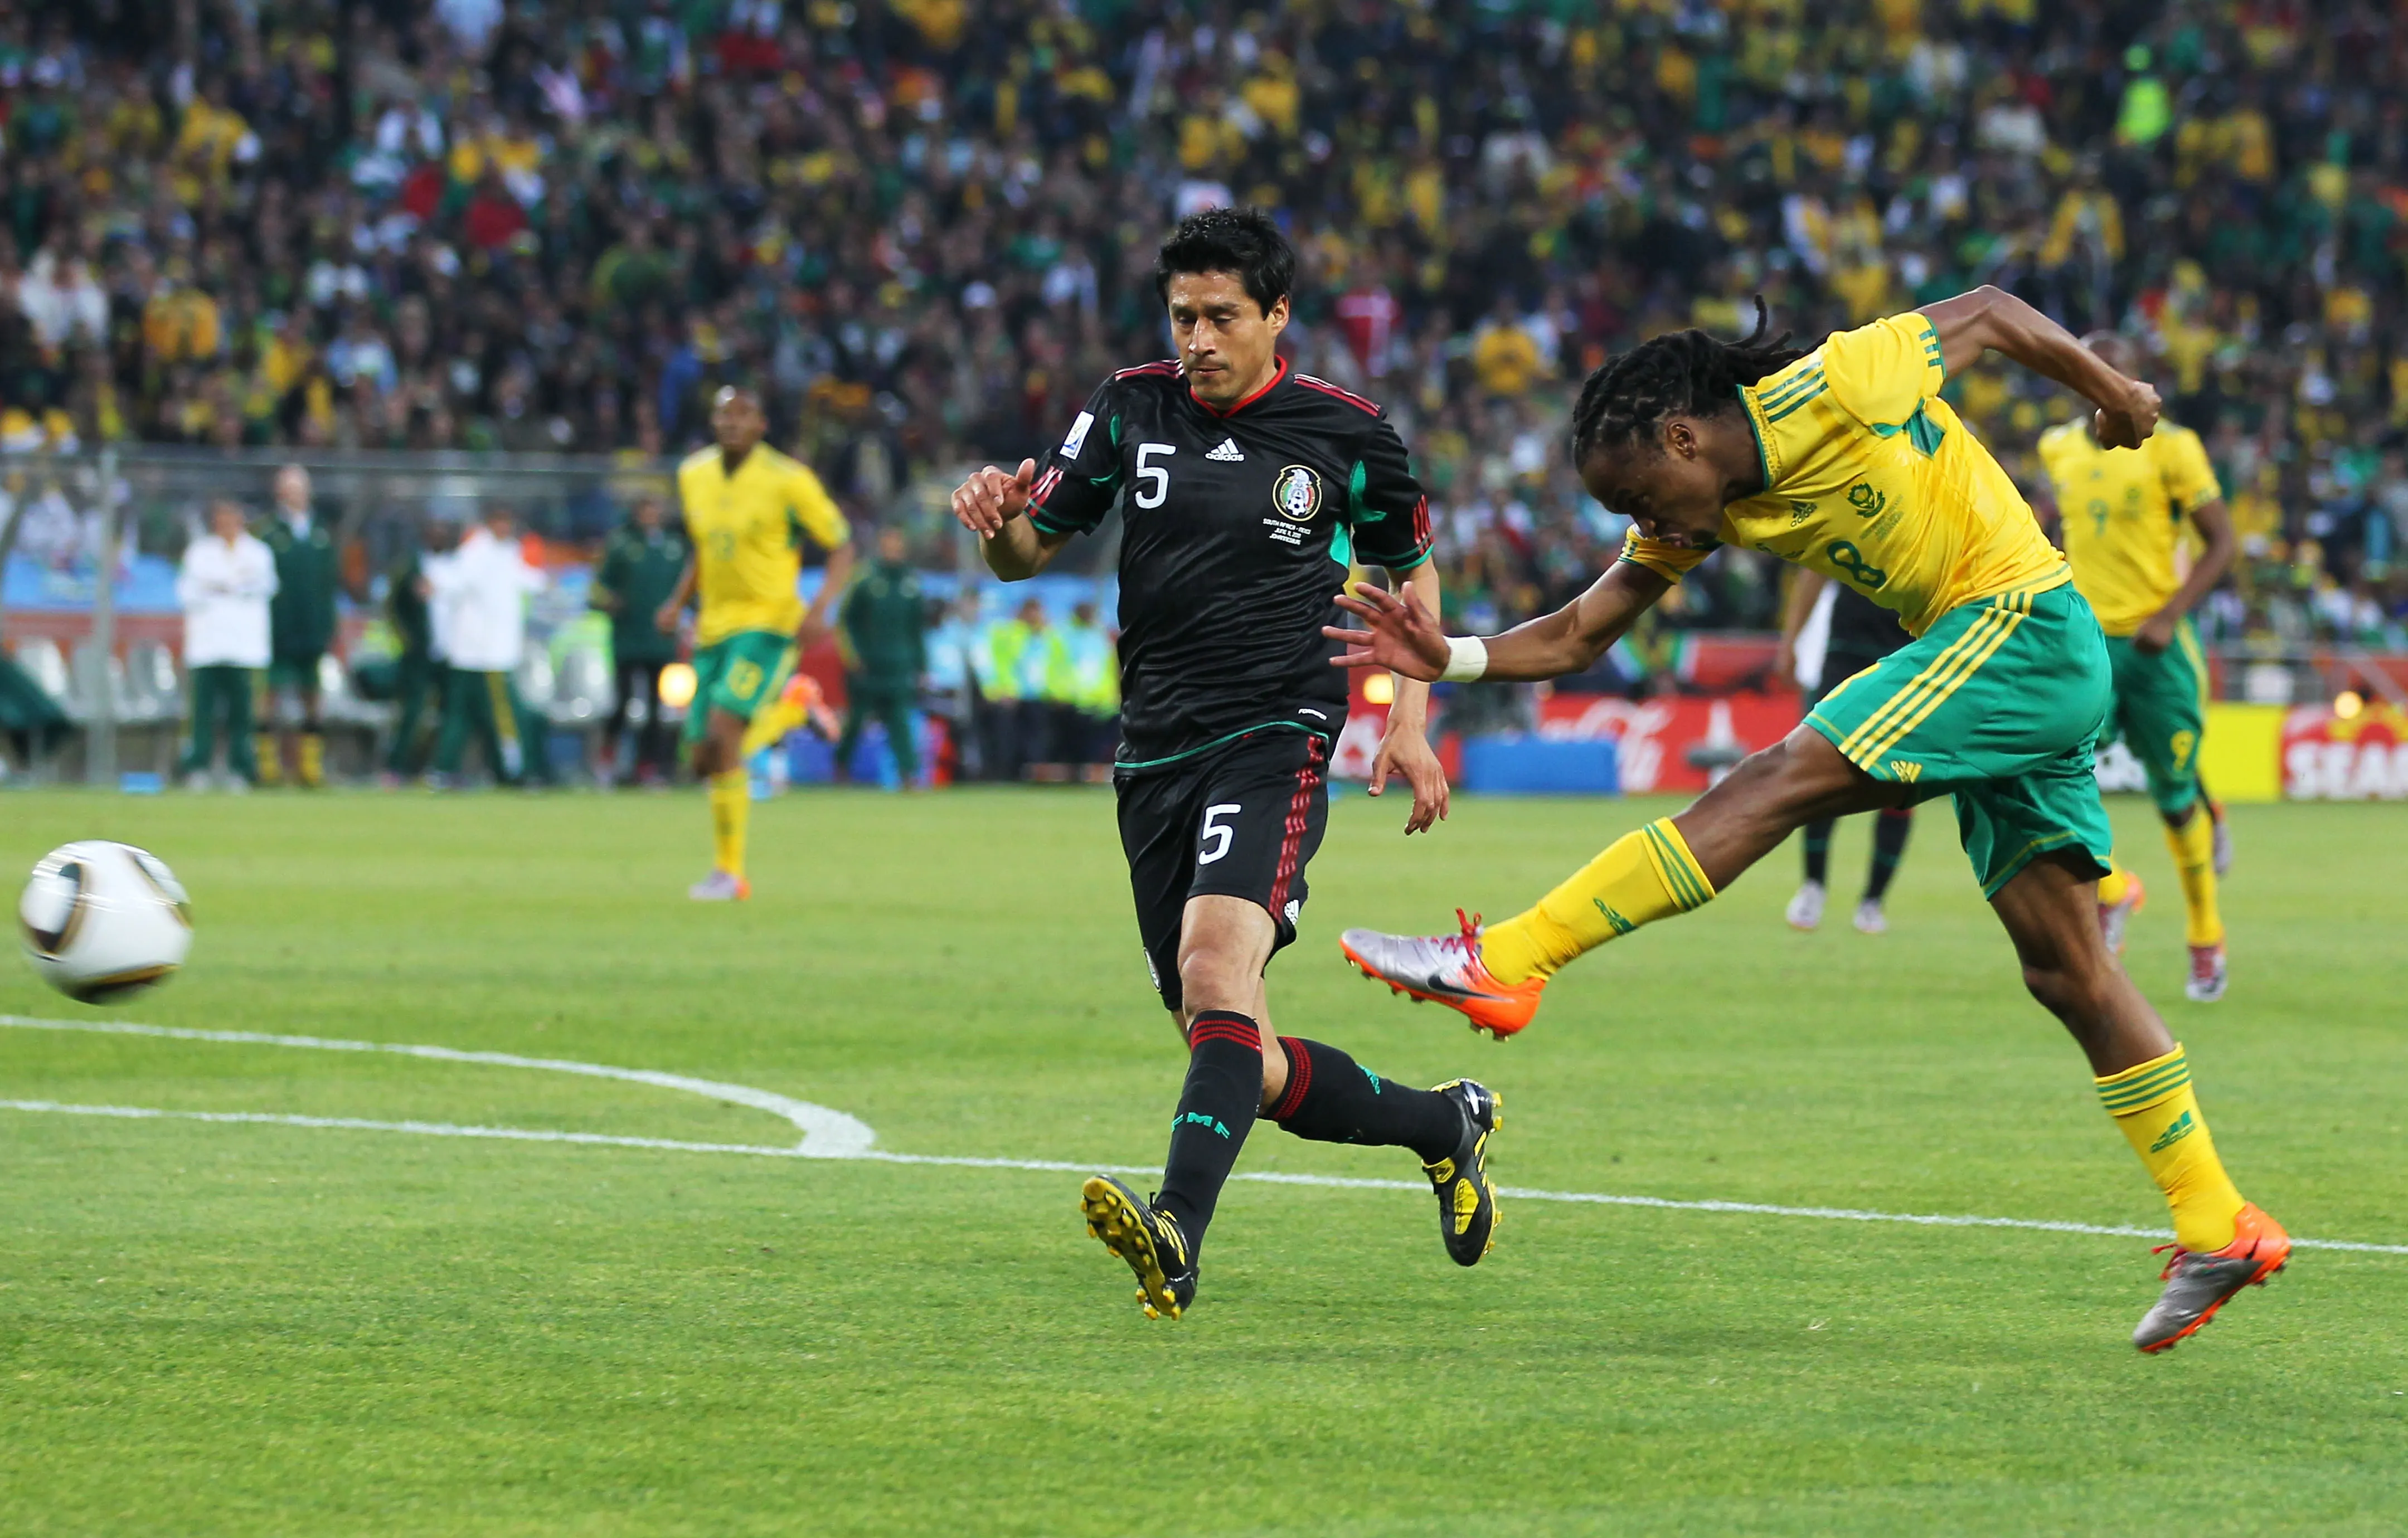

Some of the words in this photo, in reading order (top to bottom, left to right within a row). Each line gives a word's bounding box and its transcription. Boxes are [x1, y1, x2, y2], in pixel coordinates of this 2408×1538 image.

[1135, 443, 1176, 509] 5
[1205, 452, 1244, 461] adidas
[2087, 499, 2109, 538] 9
[1827, 541, 1886, 588] 8
[2171, 729, 2195, 771] 9
[1198, 804, 1241, 865] 5
